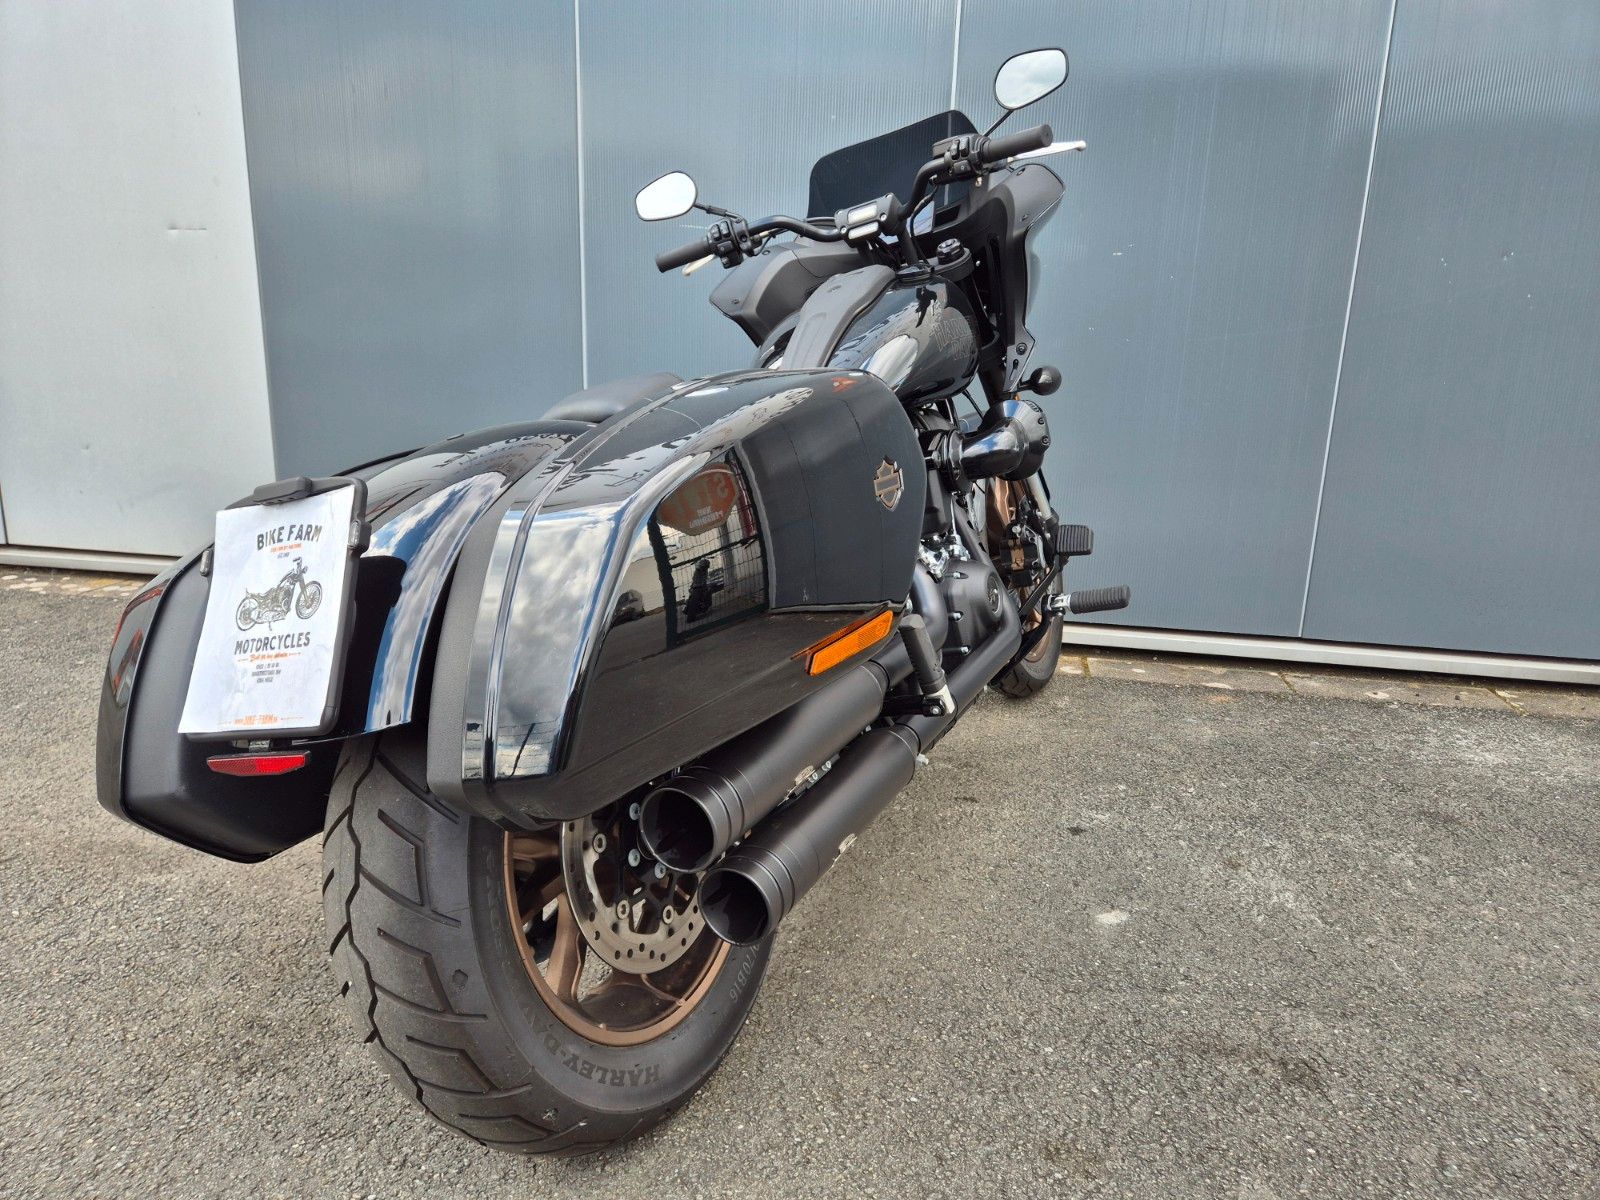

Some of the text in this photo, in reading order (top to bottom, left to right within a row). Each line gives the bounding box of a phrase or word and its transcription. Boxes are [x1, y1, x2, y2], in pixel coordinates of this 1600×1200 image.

[256, 526, 284, 551] BIKE
[287, 524, 323, 544] FARM
[234, 632, 311, 655] MOTORCYCLES
